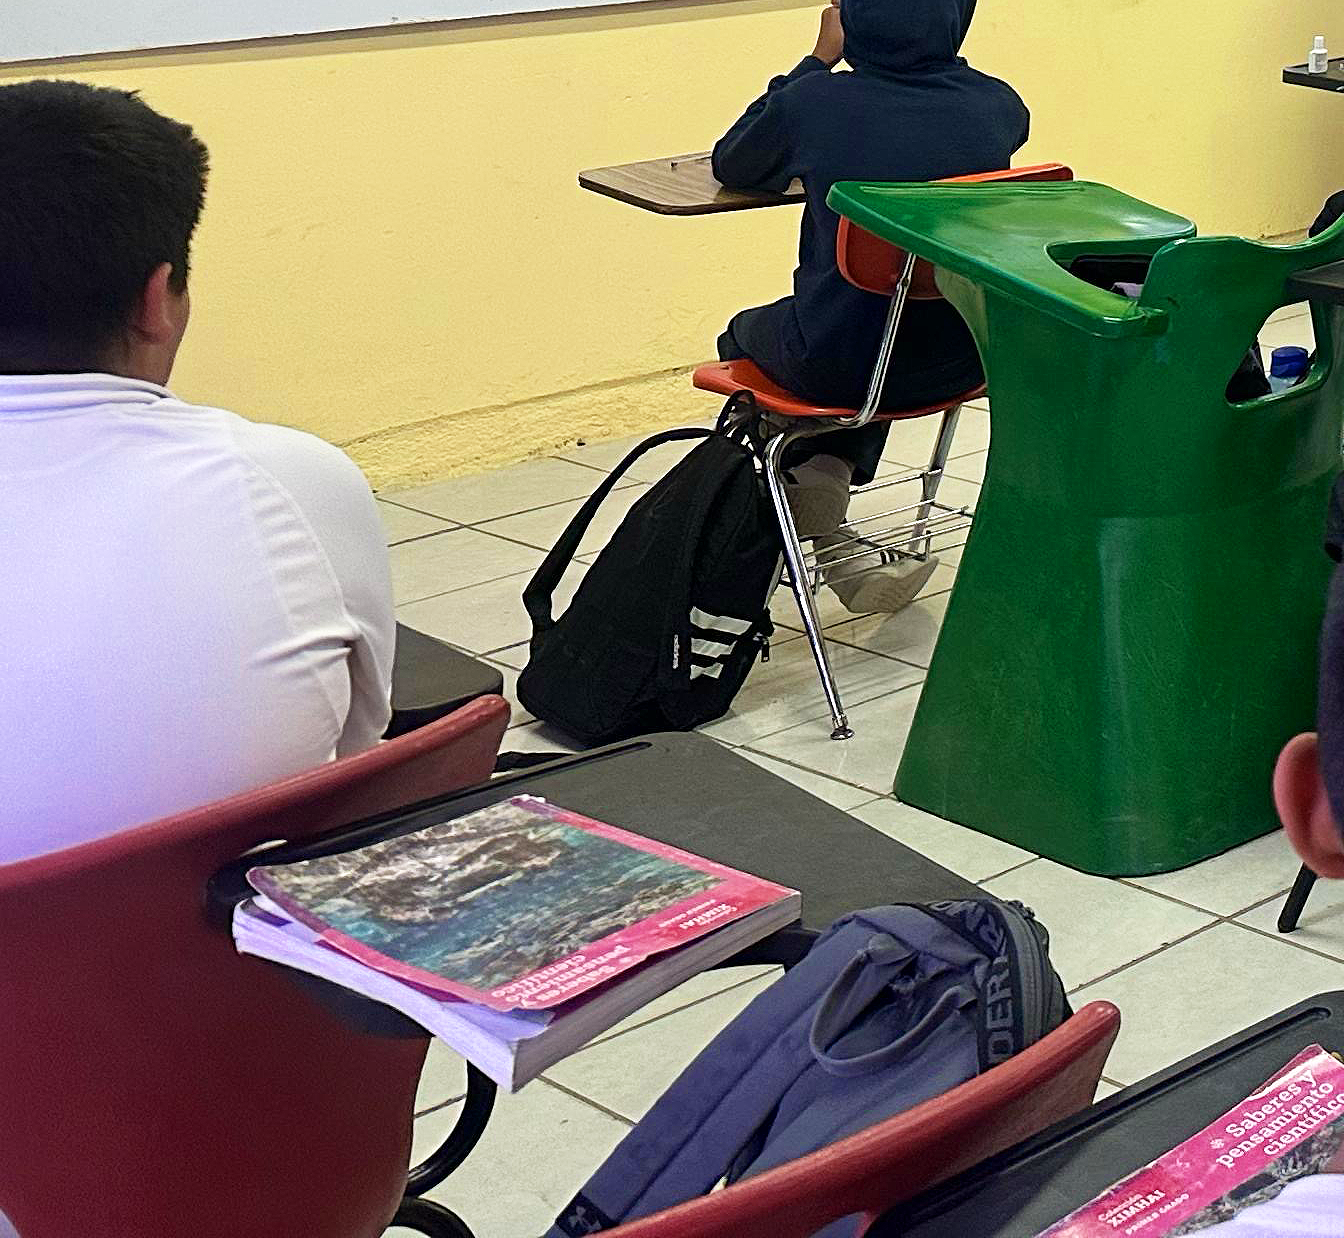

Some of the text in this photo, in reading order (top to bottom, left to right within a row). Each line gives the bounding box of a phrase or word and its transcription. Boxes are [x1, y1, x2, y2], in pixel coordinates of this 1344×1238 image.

[985, 967, 1017, 1063] DER
[1215, 1082, 1334, 1169] pensamiento
[1225, 1069, 1317, 1138] Saberes y
[1106, 1189, 1166, 1228] XIMHAI
